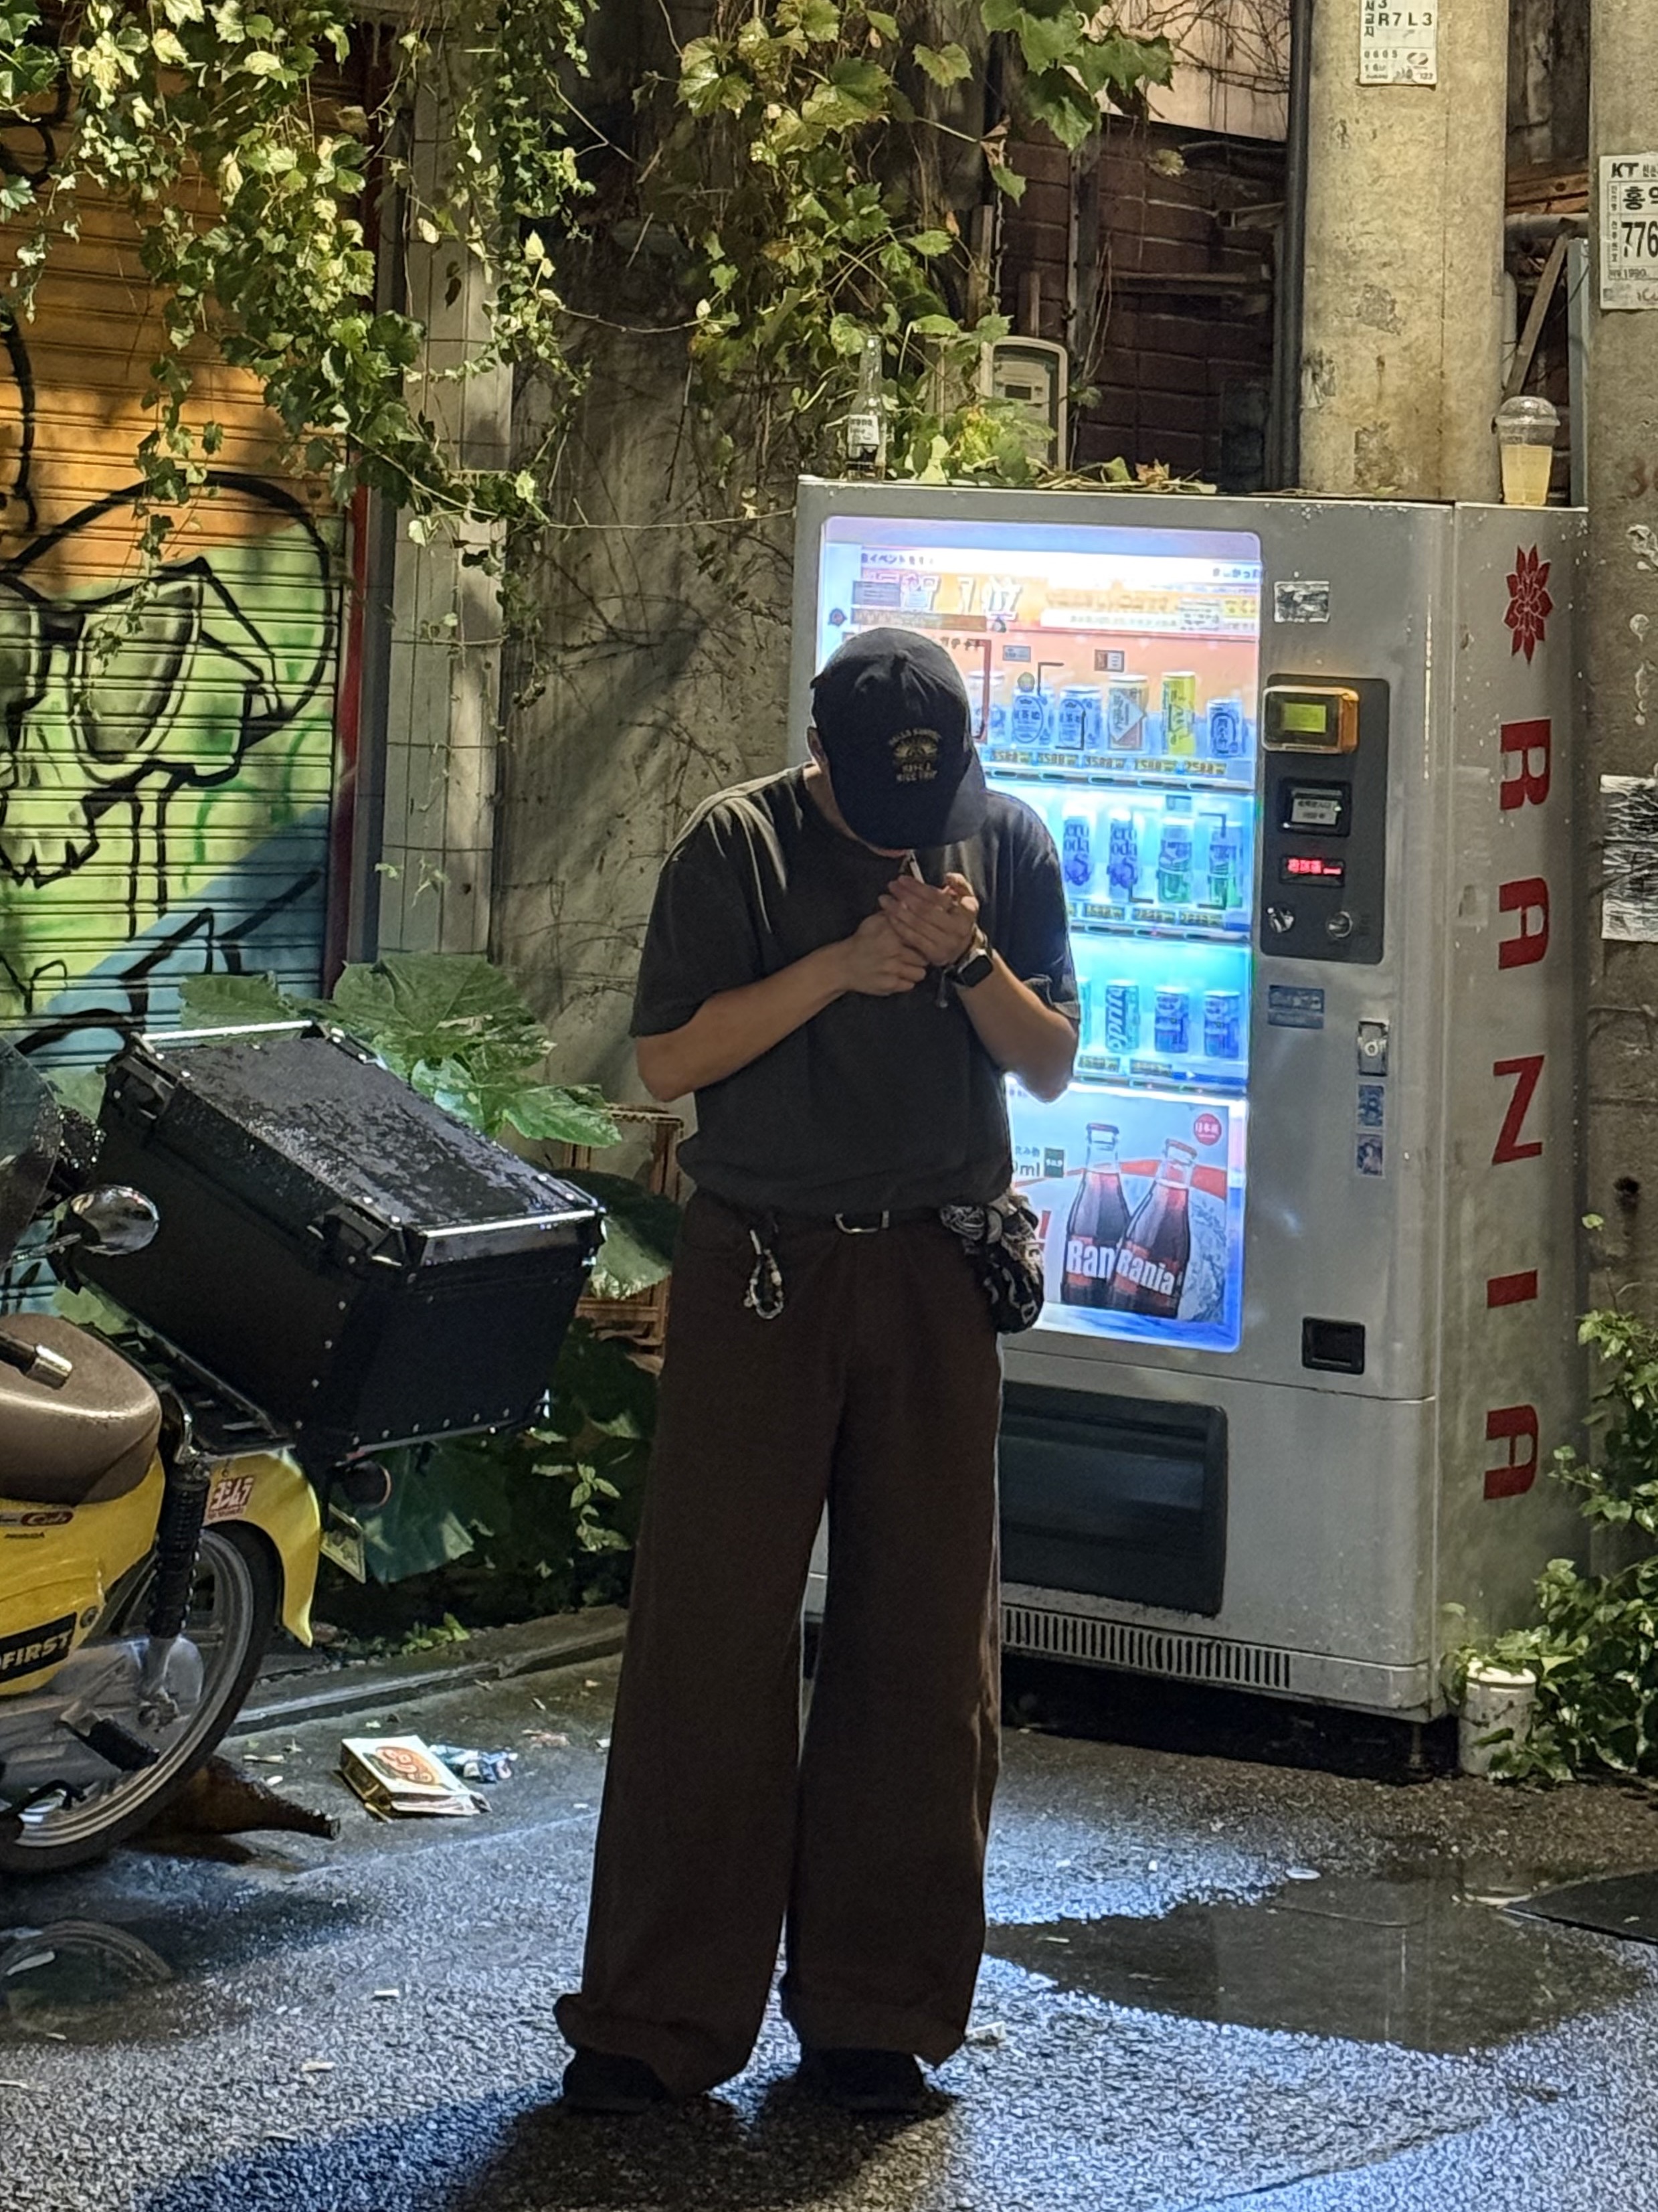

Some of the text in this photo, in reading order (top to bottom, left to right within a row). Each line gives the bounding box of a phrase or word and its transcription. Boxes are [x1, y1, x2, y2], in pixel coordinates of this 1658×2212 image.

[1611, 163, 1639, 178] KT
[1065, 824, 1089, 837] ero
[1113, 827, 1137, 841] ero
[1064, 837, 1089, 853] oda
[1111, 839, 1137, 855] oda
[1484, 717, 1552, 1501] RANIA
